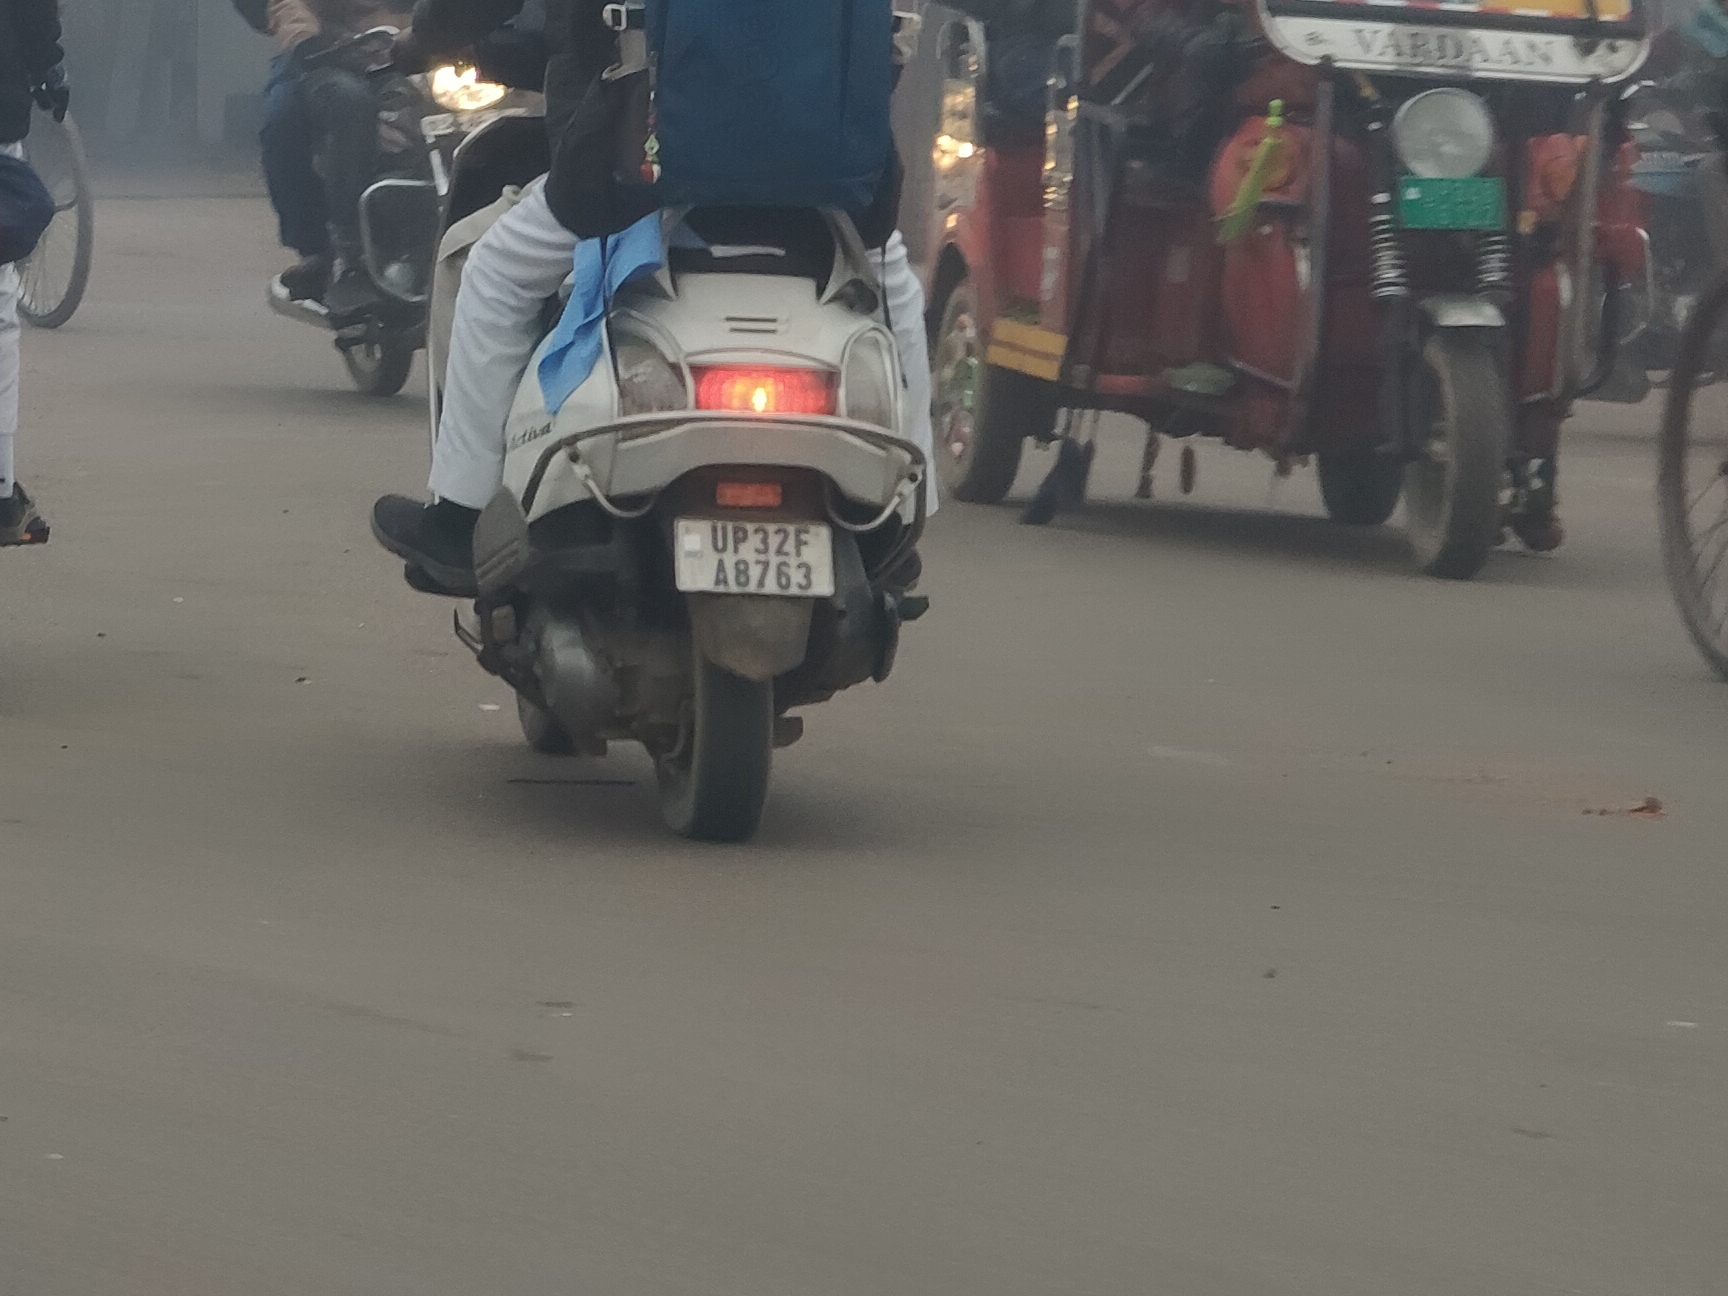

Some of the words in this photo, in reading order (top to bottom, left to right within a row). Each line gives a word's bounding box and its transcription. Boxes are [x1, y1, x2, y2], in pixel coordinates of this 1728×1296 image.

[1354, 27, 1556, 67] VARDAAN
[711, 521, 811, 557] UP32F
[714, 558, 812, 591] A8763
